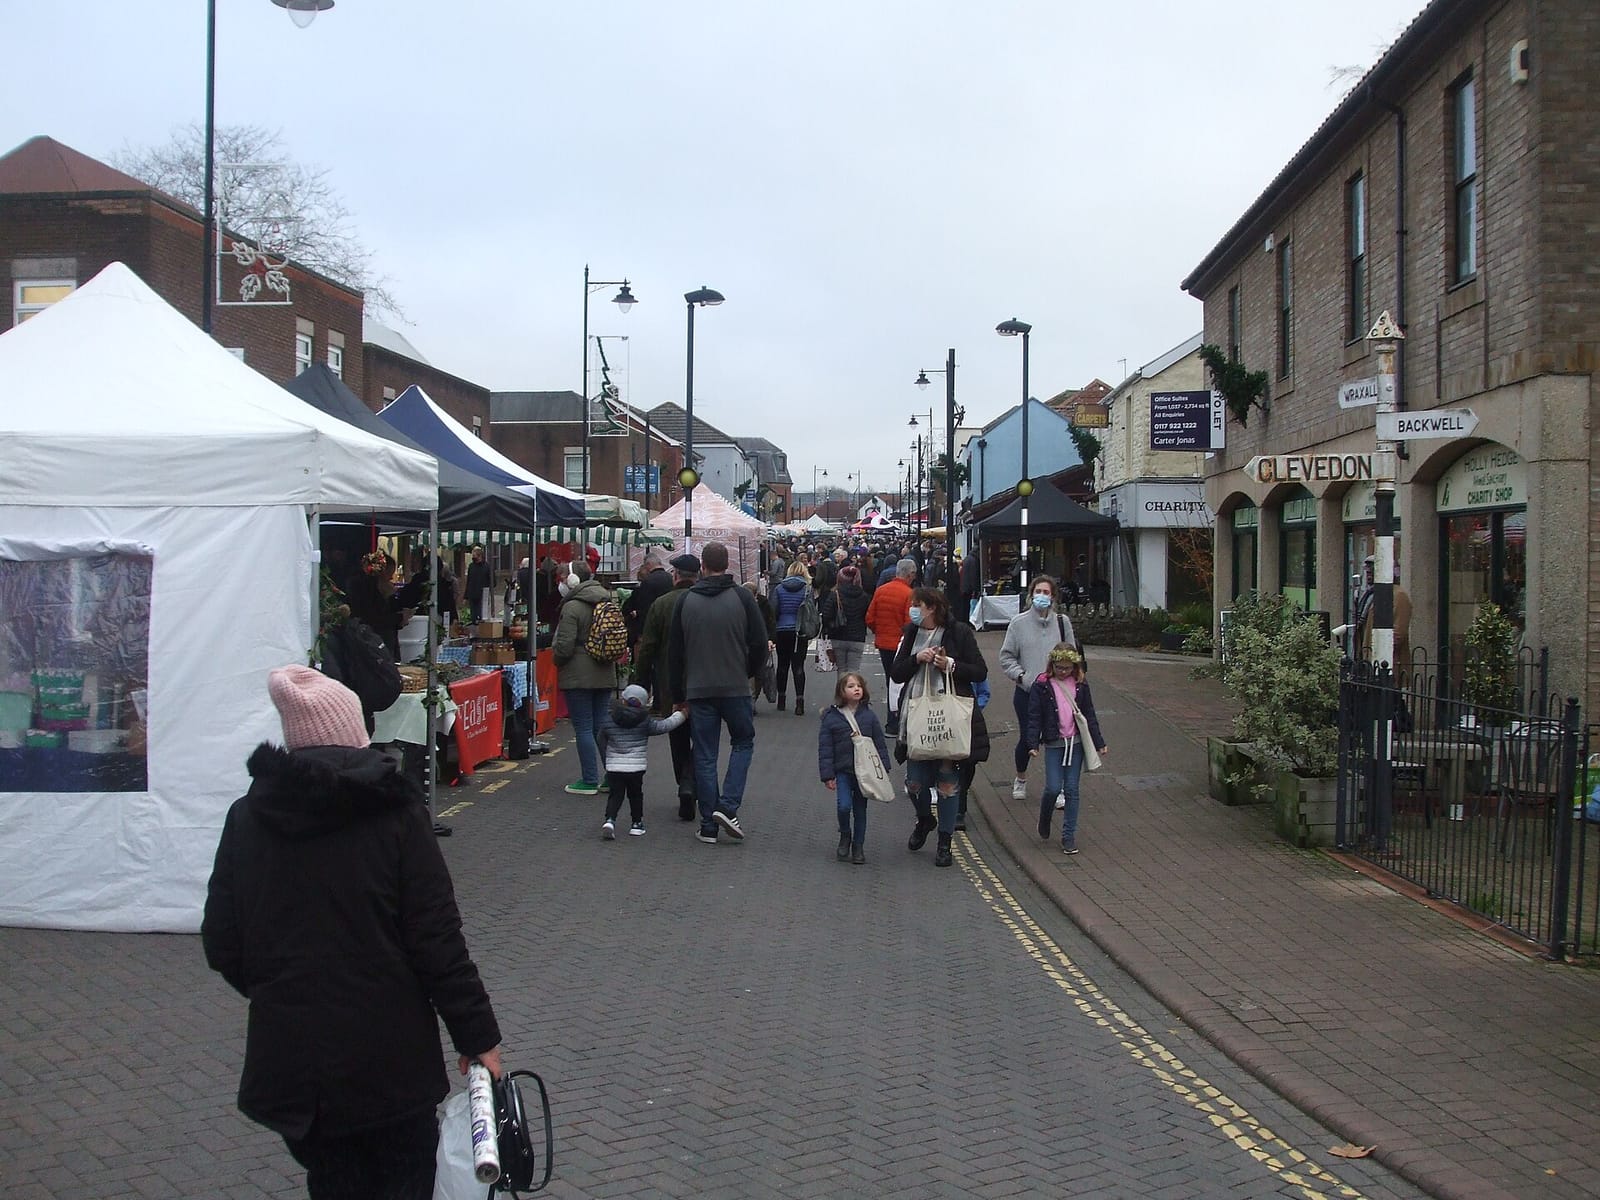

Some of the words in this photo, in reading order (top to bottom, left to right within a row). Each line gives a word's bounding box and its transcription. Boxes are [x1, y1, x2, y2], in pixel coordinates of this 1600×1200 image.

[1379, 316, 1386, 326] S
[1343, 383, 1378, 402] WRAXALL
[1162, 411, 1185, 419] Enquiries
[1213, 411, 1222, 430] LET
[1398, 416, 1464, 433] BACKWELL
[1153, 437, 1176, 445] Carter
[1176, 436, 1196, 446] Jonas
[1464, 455, 1489, 472] HOLLY
[1490, 450, 1520, 468] HEDGE
[1258, 455, 1372, 482] CLEVEDON
[1467, 489, 1494, 505] CHARITY
[1495, 486, 1513, 502] SHOP
[1145, 501, 1206, 512] CHARITY
[928, 709, 944, 717] PLAN
[927, 717, 946, 725] TEACH
[928, 724, 945, 732] MARK
[920, 727, 957, 748] Repeat
